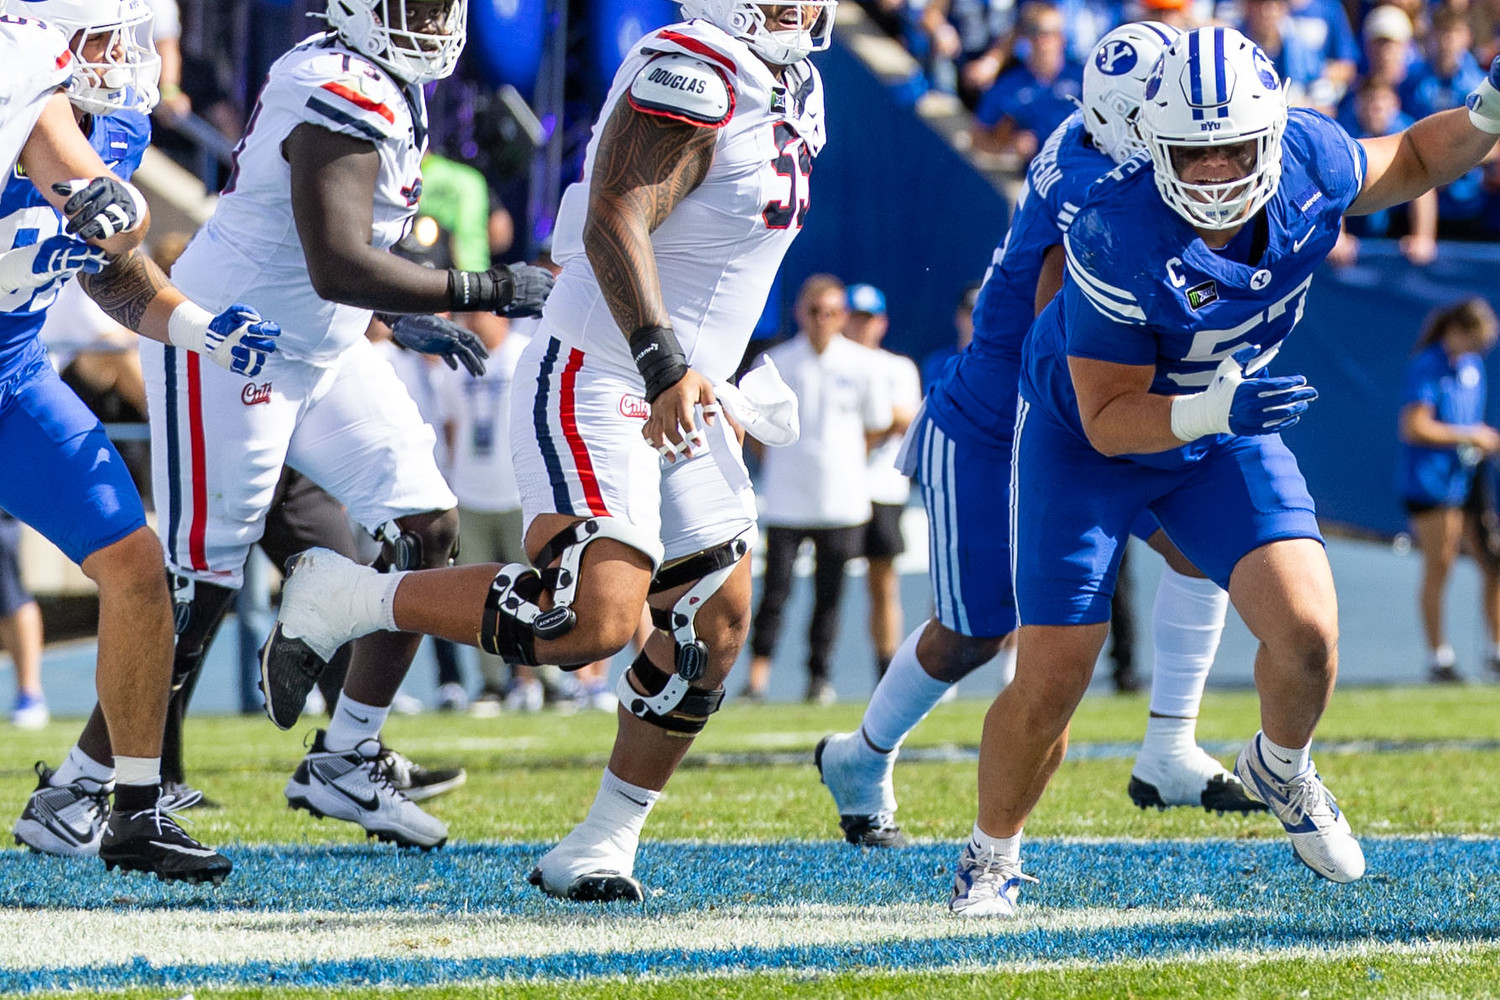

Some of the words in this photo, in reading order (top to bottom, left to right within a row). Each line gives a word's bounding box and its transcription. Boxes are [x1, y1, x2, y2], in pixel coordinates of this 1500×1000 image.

[1101, 41, 1133, 73] Y
[647, 67, 706, 94] DOUGLAS
[1201, 120, 1221, 131] BYU
[1301, 191, 1322, 212] entrata
[1166, 257, 1186, 288] C
[1253, 272, 1267, 287] Y
[1167, 272, 1313, 387] 57
